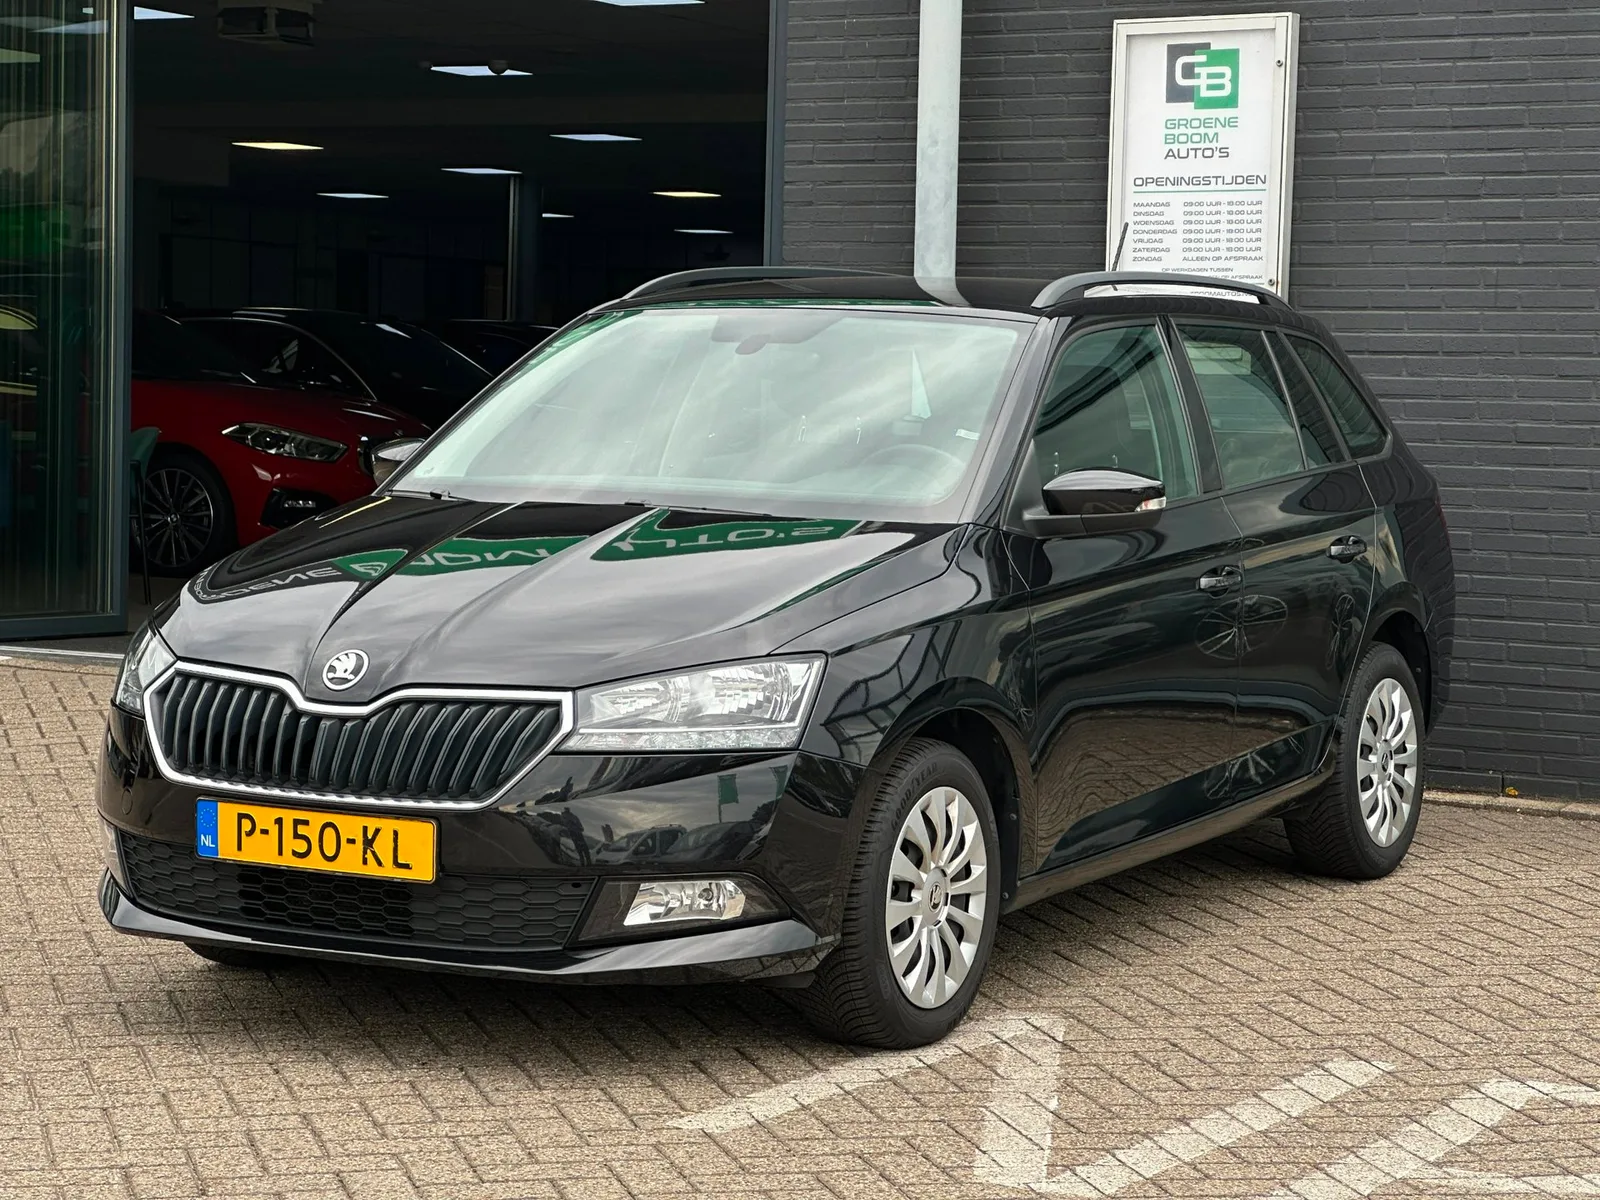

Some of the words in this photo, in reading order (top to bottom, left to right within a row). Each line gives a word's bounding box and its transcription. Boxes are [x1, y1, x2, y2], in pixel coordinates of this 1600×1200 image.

[1164, 117, 1239, 130] GROENE
[1164, 133, 1219, 145] BOOM
[1164, 147, 1230, 160] AUTO'S
[1133, 174, 1267, 187] OPENINGSTIJDEN
[200, 835, 216, 848] NL
[236, 812, 412, 870] P-150-KL
